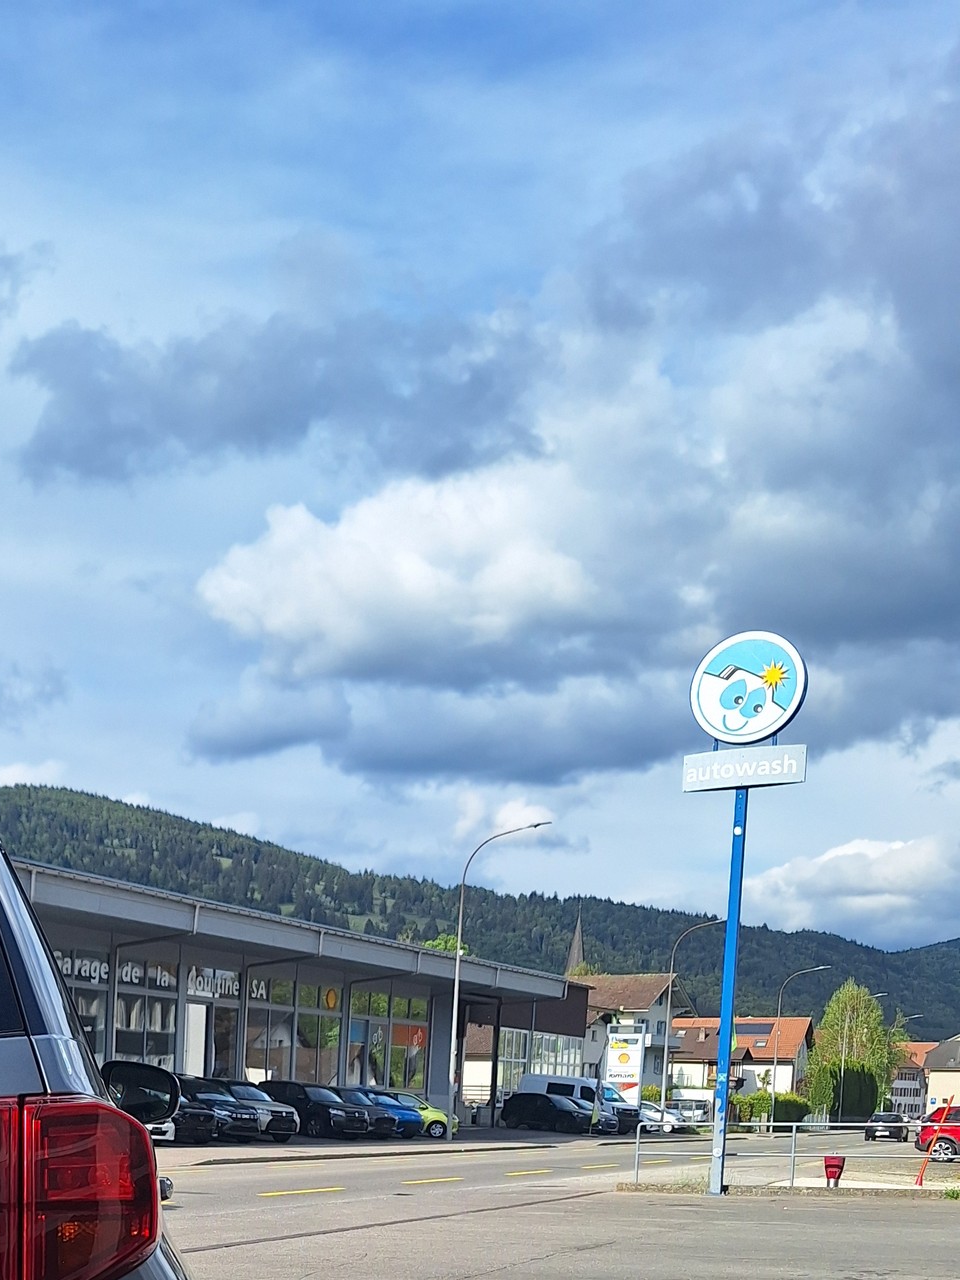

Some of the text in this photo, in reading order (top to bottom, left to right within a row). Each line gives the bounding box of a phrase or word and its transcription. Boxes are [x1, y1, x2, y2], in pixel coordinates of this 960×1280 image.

[686, 754, 797, 782] autowash
[121, 961, 140, 984] de
[156, 965, 170, 987] la
[251, 979, 267, 999] SA
